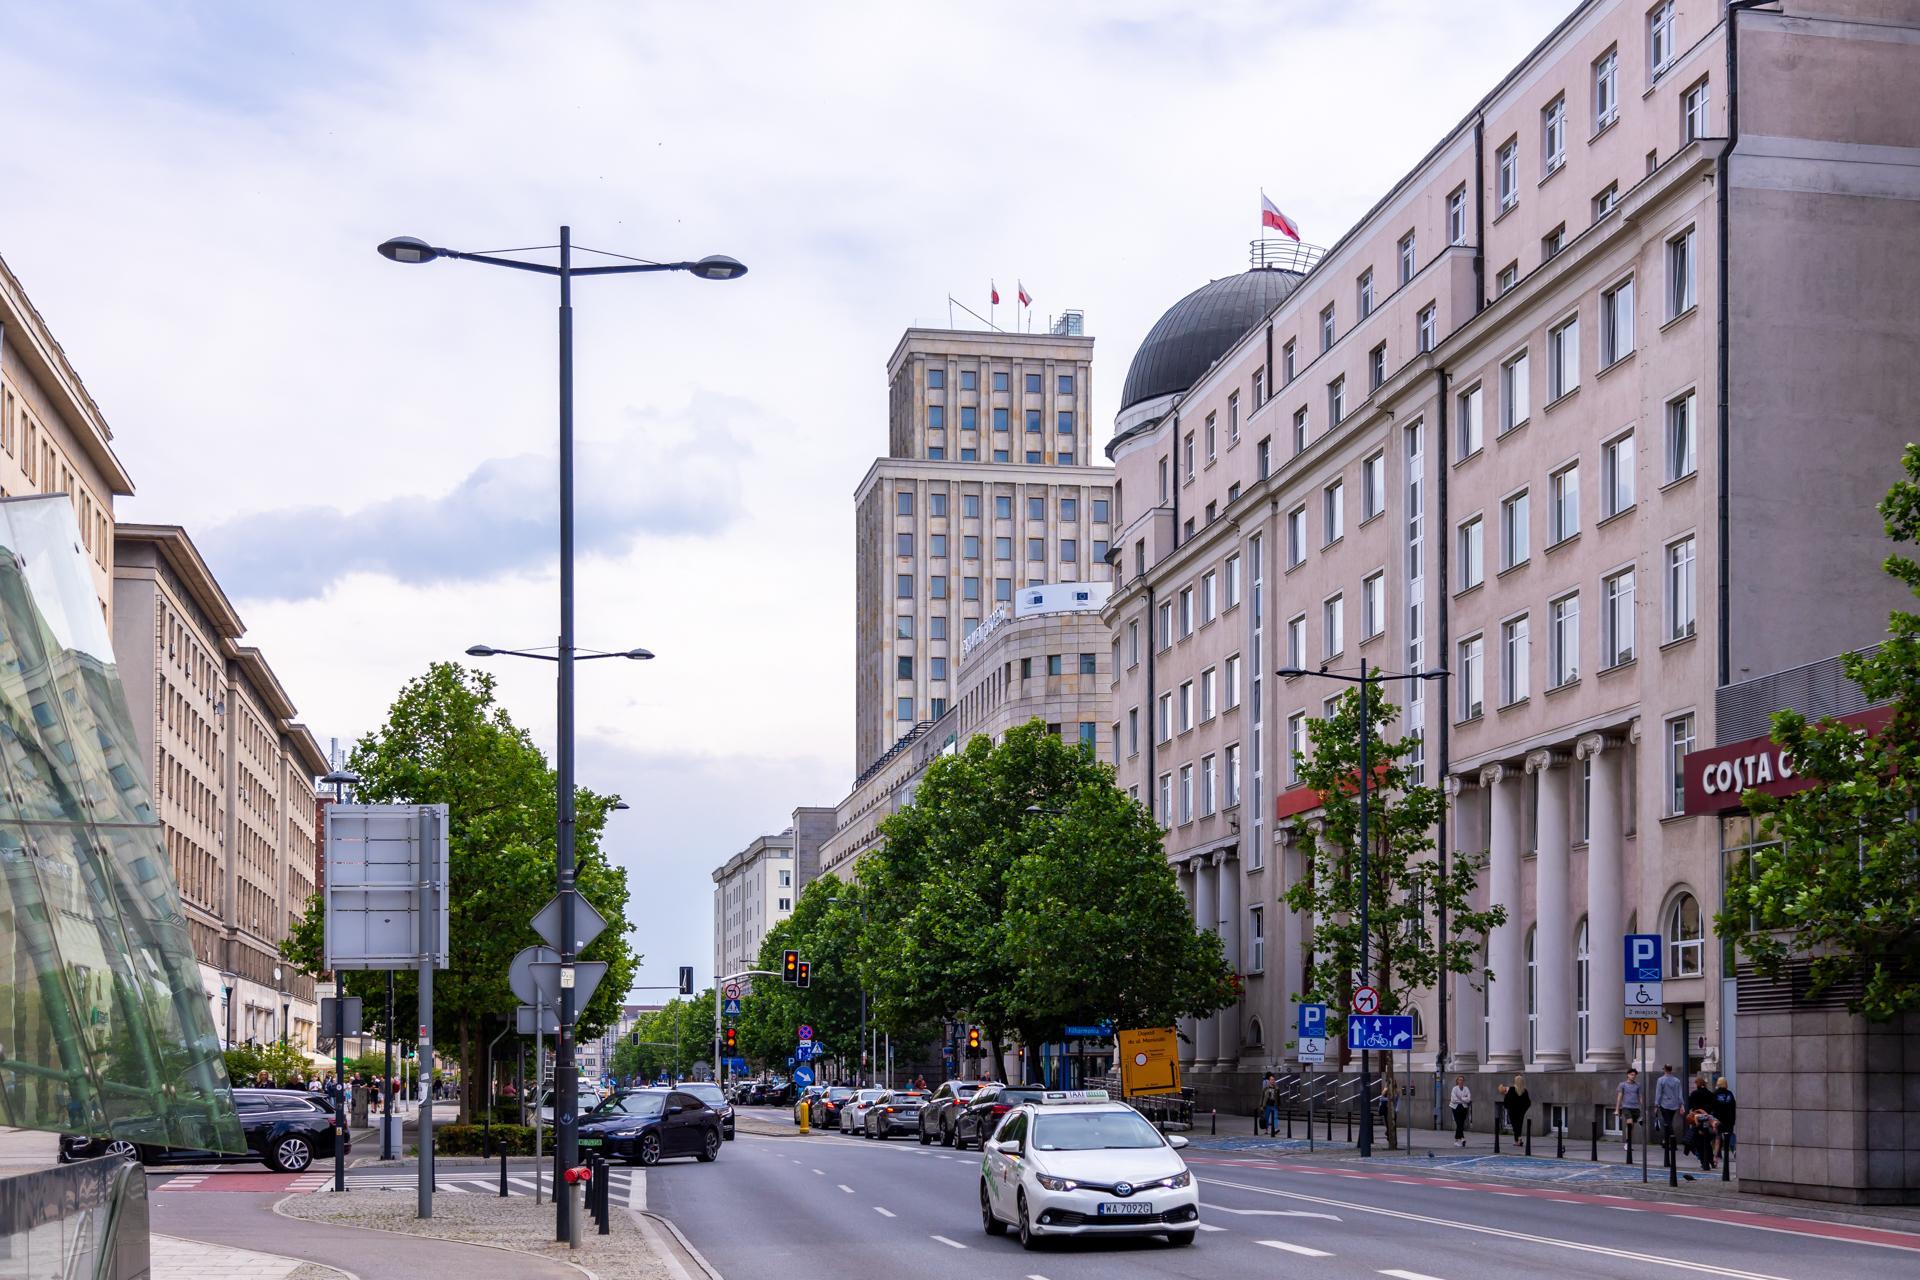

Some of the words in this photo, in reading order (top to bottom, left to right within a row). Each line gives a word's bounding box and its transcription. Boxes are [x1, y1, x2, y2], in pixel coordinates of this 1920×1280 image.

[1703, 752, 1773, 794] COSTA
[1633, 938, 1654, 968] P
[1305, 1007, 1320, 1028] P
[1632, 1021, 1650, 1033] 719
[788, 1057, 795, 1066] P
[1069, 1091, 1084, 1099] TAXI
[1105, 1204, 1118, 1213] WA
[1121, 1204, 1149, 1213] 7092G
